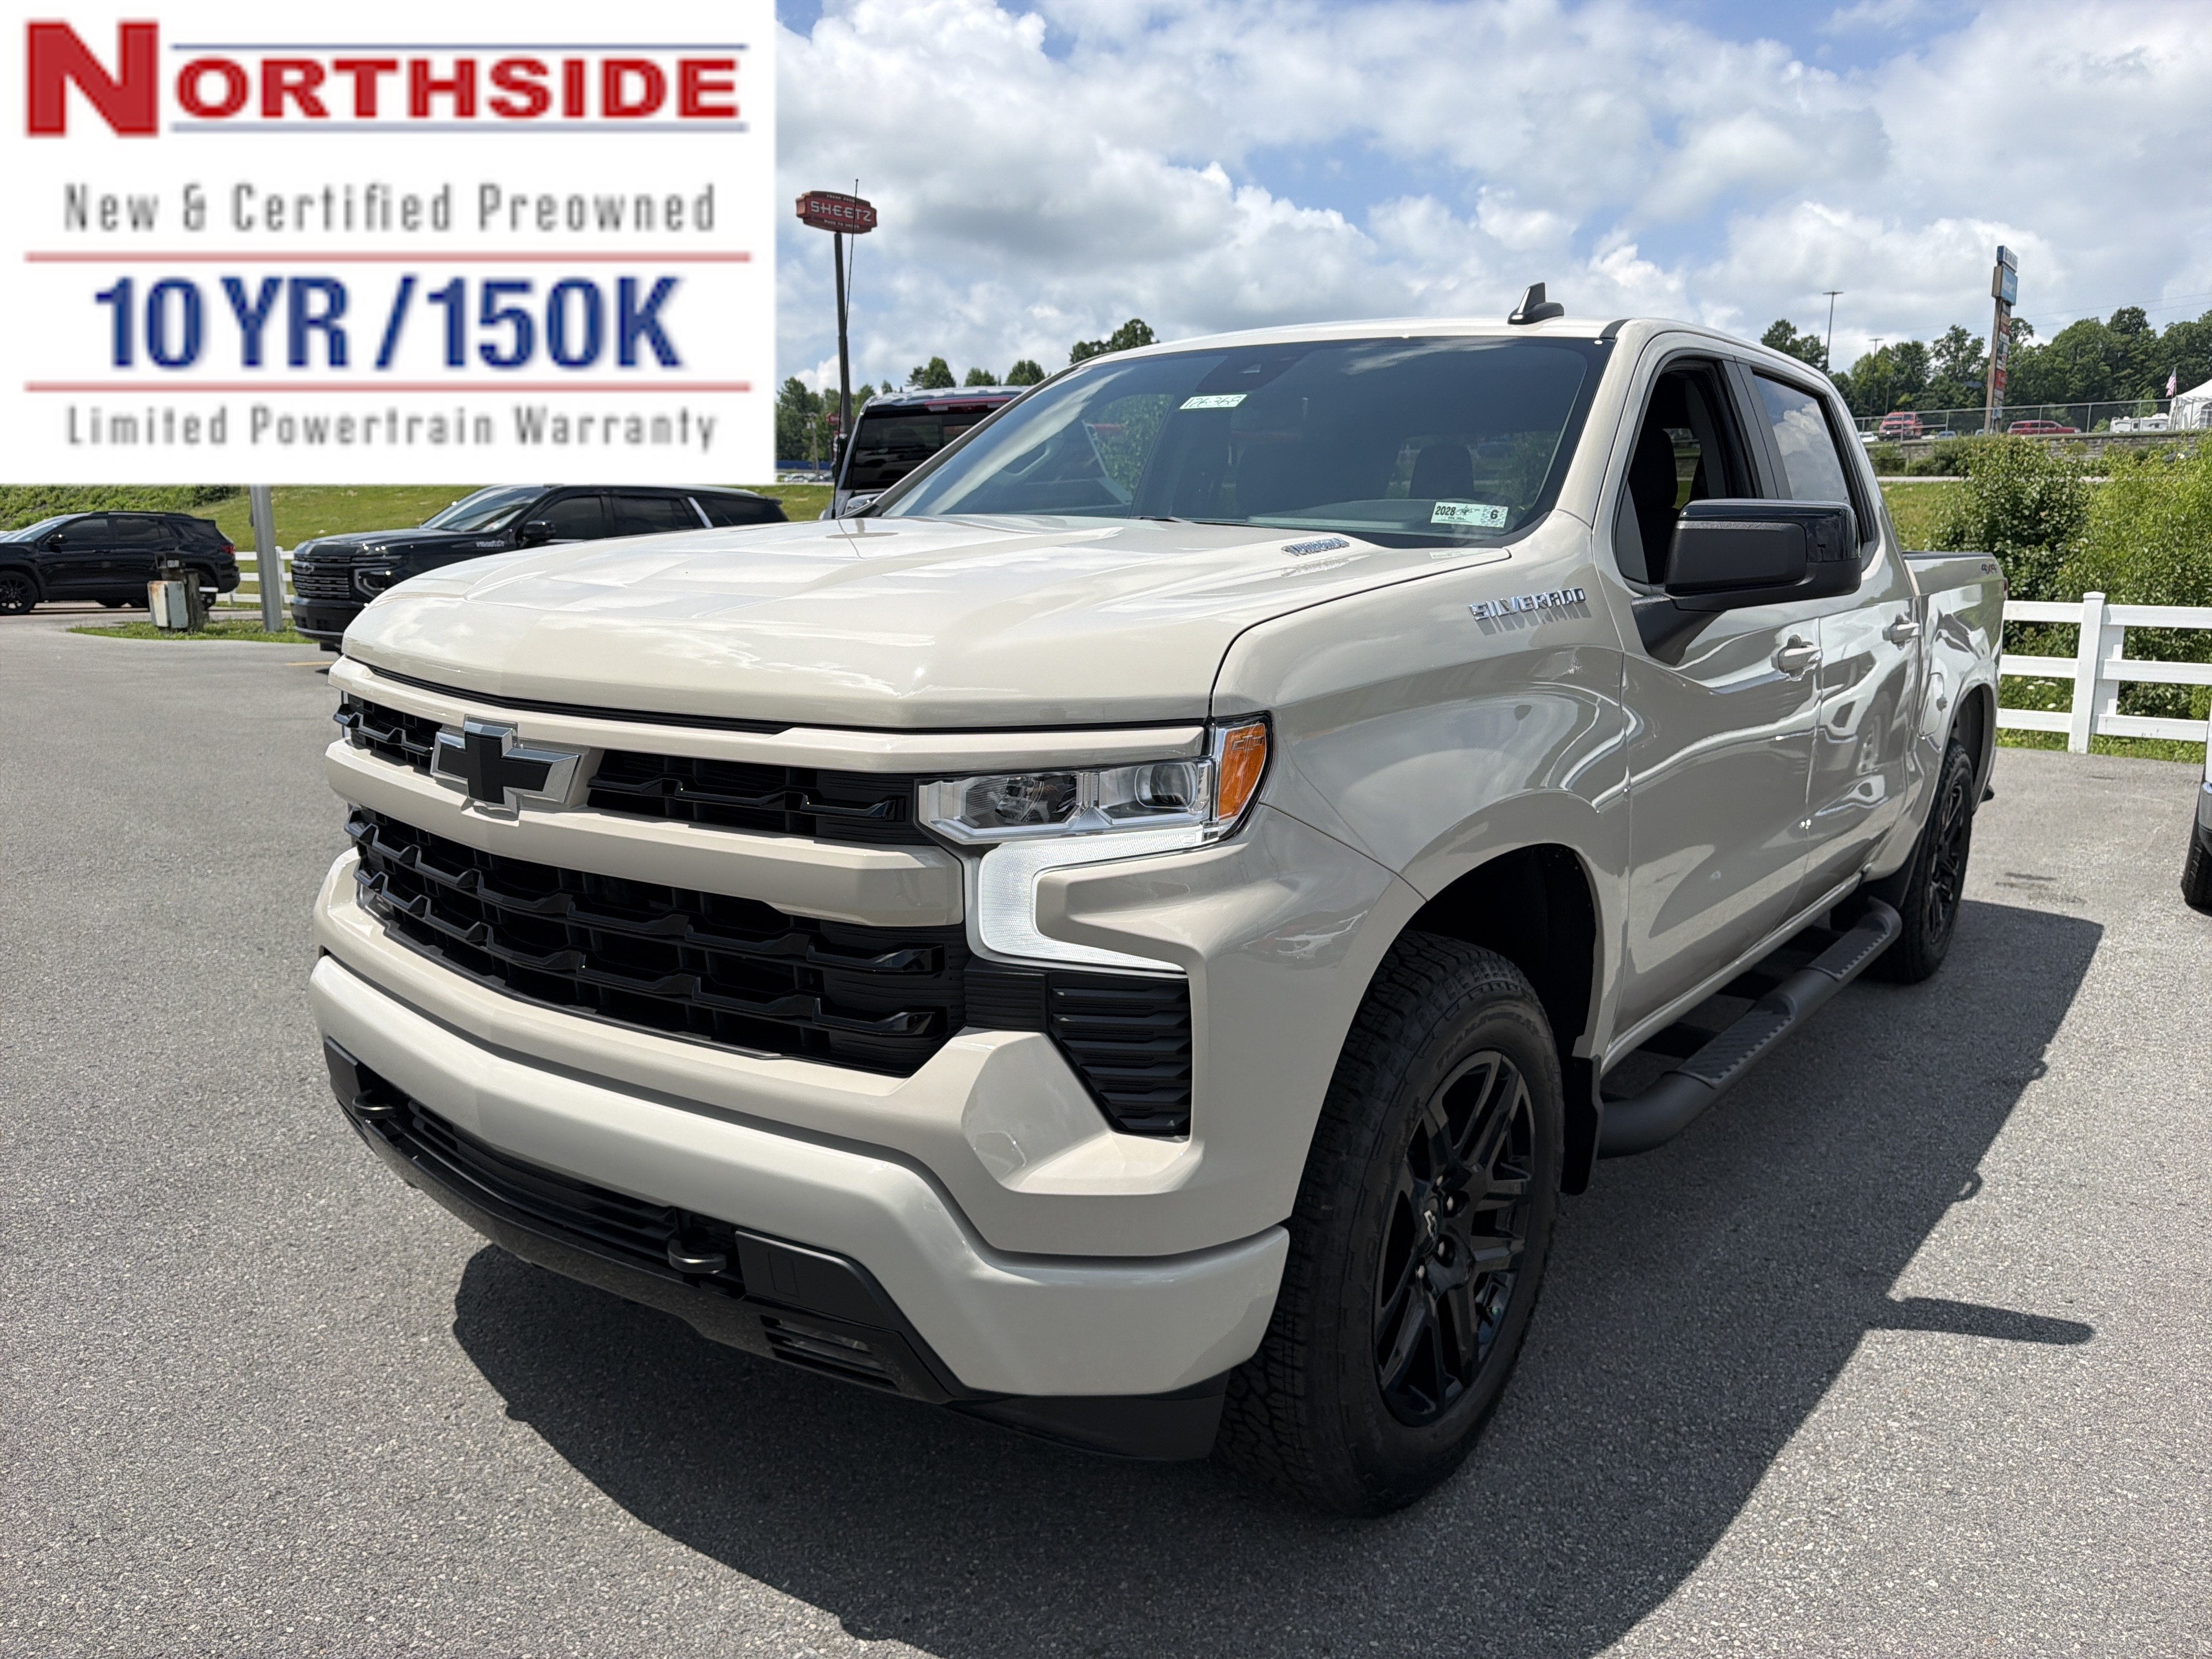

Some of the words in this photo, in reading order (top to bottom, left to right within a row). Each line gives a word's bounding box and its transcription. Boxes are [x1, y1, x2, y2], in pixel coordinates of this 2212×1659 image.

[810, 201, 872, 222] SHEETZ
[1435, 505, 1457, 516] 2028
[1490, 509, 1499, 520] 6
[1469, 588, 1587, 622] SILVERADO
